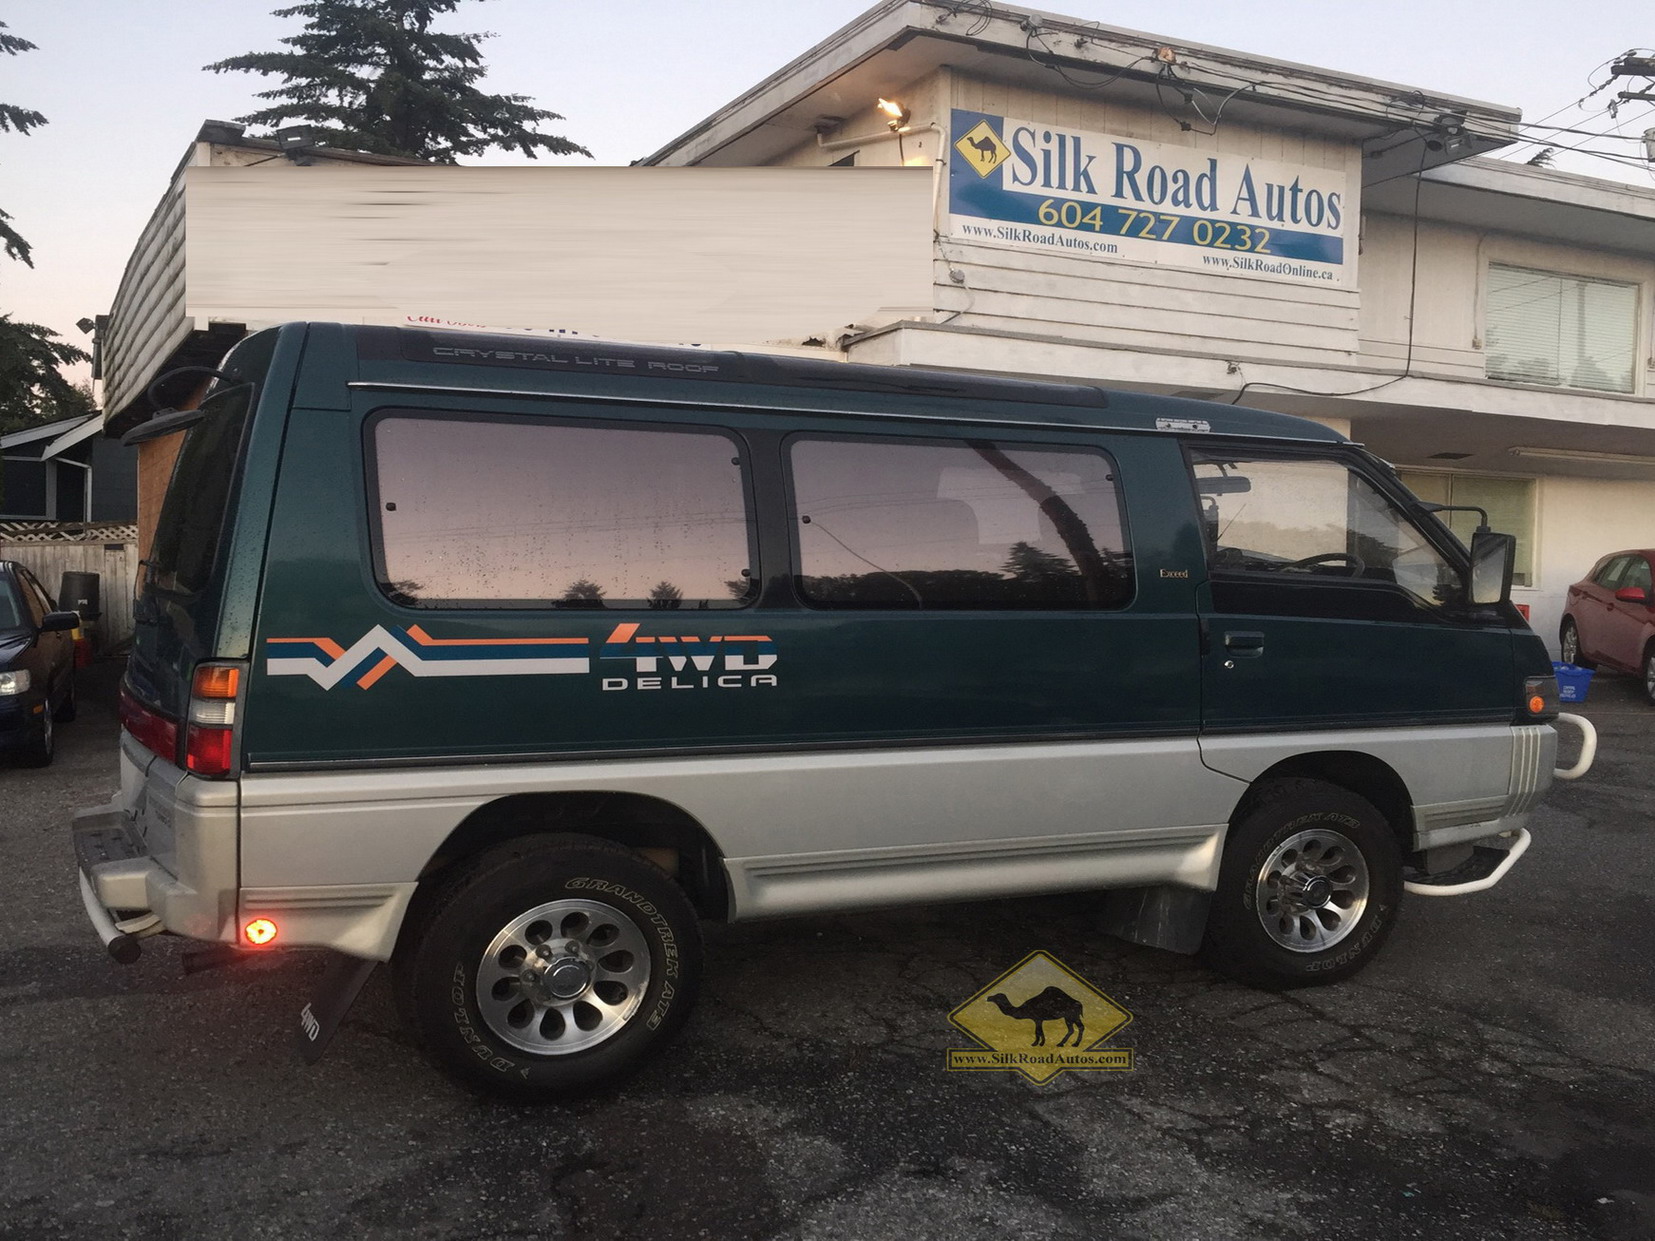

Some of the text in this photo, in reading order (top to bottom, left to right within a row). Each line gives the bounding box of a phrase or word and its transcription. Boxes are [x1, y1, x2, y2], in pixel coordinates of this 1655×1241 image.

[1011, 127, 1342, 231] Silk Road Autos
[962, 223, 1118, 254] www.SilkRoadAutos.com
[1038, 199, 1272, 254] 604 727 0232
[1202, 253, 1333, 281] www.SilkRoadOnline.ca
[433, 347, 719, 374] CRYSTAL LITE ROOF
[1160, 569, 1188, 578] Exceed
[602, 674, 778, 691] DELICA
[565, 877, 679, 979] GRANDTREK
